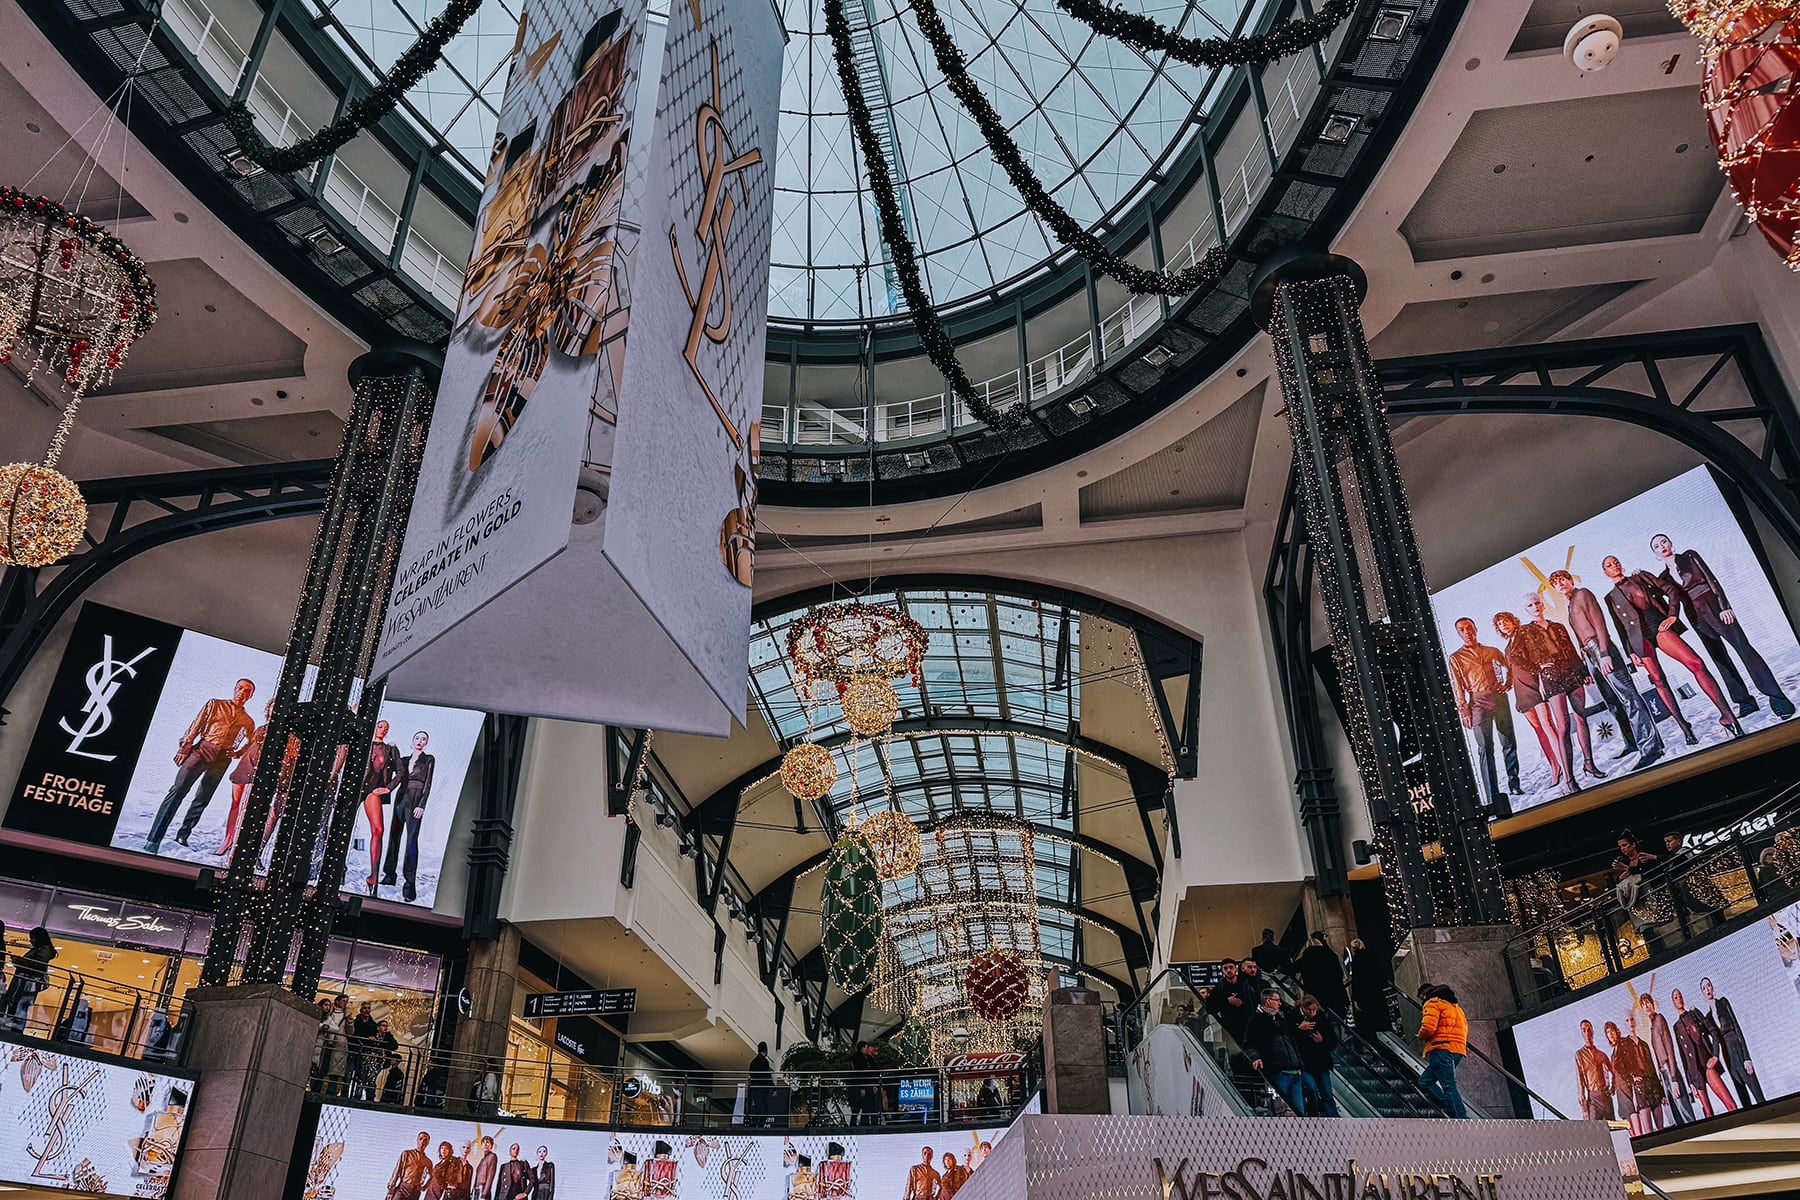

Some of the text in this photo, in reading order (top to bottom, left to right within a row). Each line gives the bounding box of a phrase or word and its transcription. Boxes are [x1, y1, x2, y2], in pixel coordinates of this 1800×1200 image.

[400, 487, 512, 586] WRAP IN FLOWERS
[394, 500, 521, 607] CELEBRATE IN GOLD
[58, 634, 158, 762] YSL
[23, 784, 114, 815] FESTTAGE
[42, 772, 106, 798] FROHE
[67, 904, 173, 933] Thomas Sabo
[529, 997, 538, 1014] 1
[557, 1032, 577, 1051] LACOSTE
[900, 1089, 909, 1098] ES
